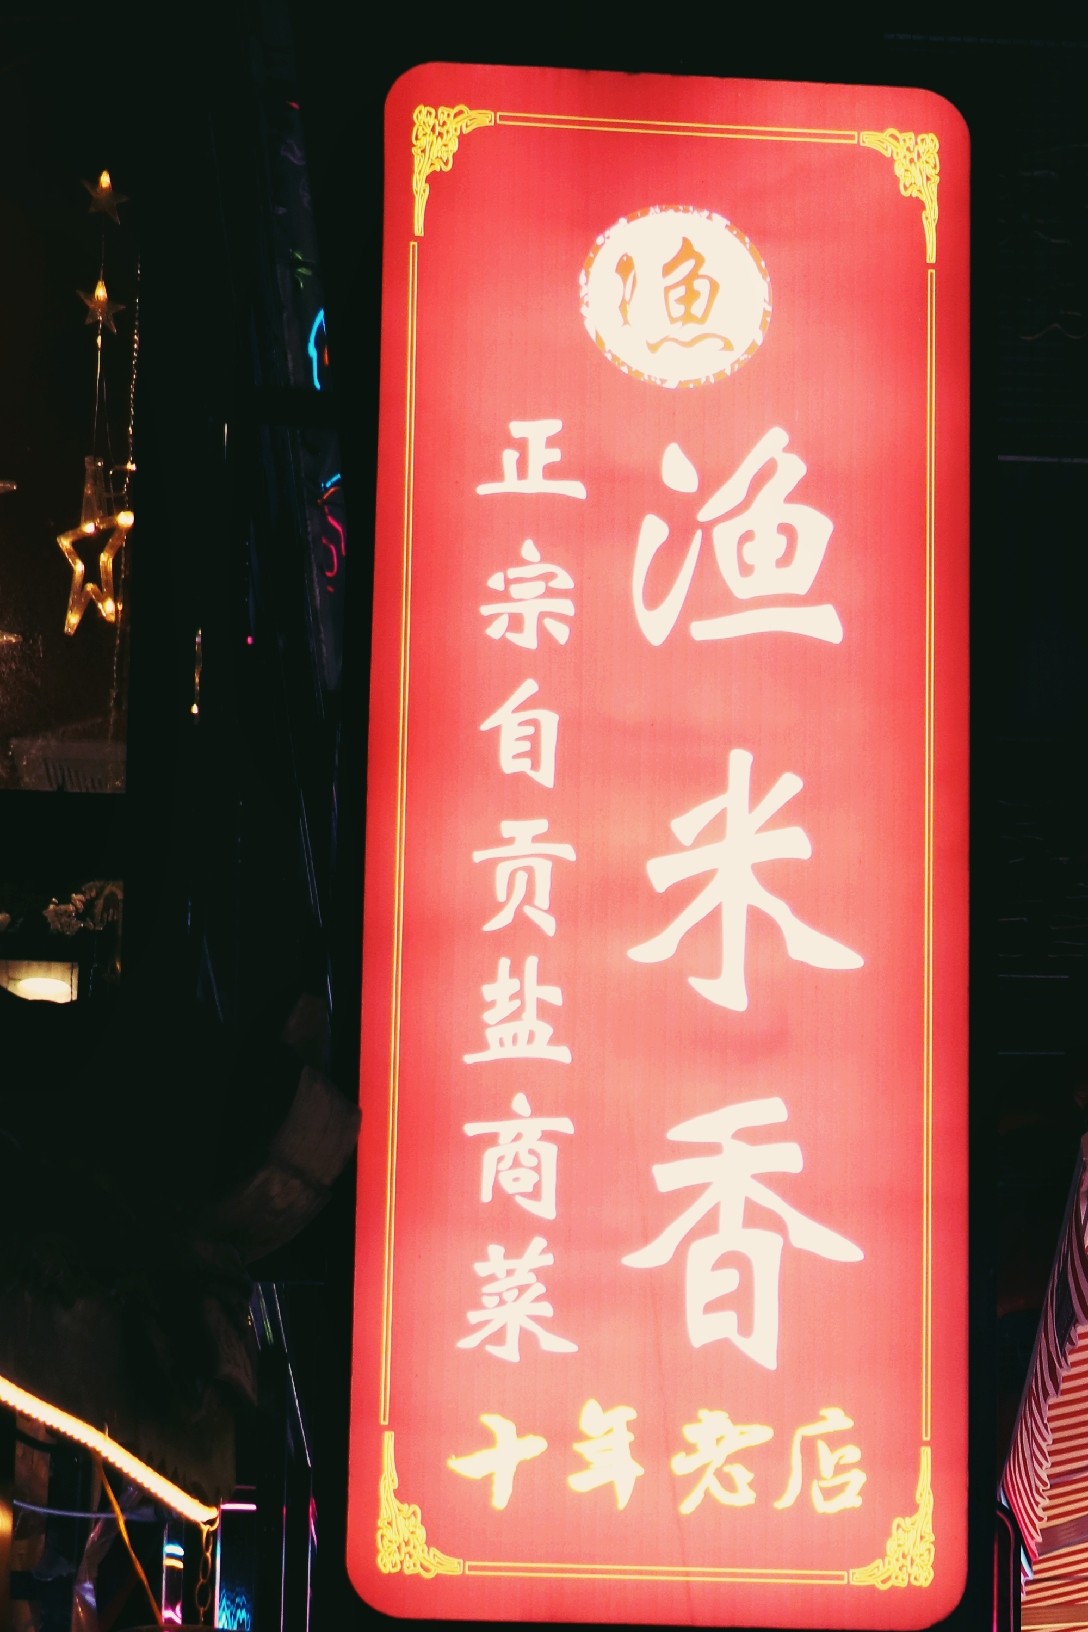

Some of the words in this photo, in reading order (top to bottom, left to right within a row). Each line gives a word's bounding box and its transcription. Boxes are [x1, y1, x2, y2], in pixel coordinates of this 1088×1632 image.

[614, 236, 734, 355] 渔
[456, 418, 587, 1362] 正宗自贡盐商菜
[622, 426, 865, 1370] 渔米香
[448, 1400, 867, 1514] 十年老店
